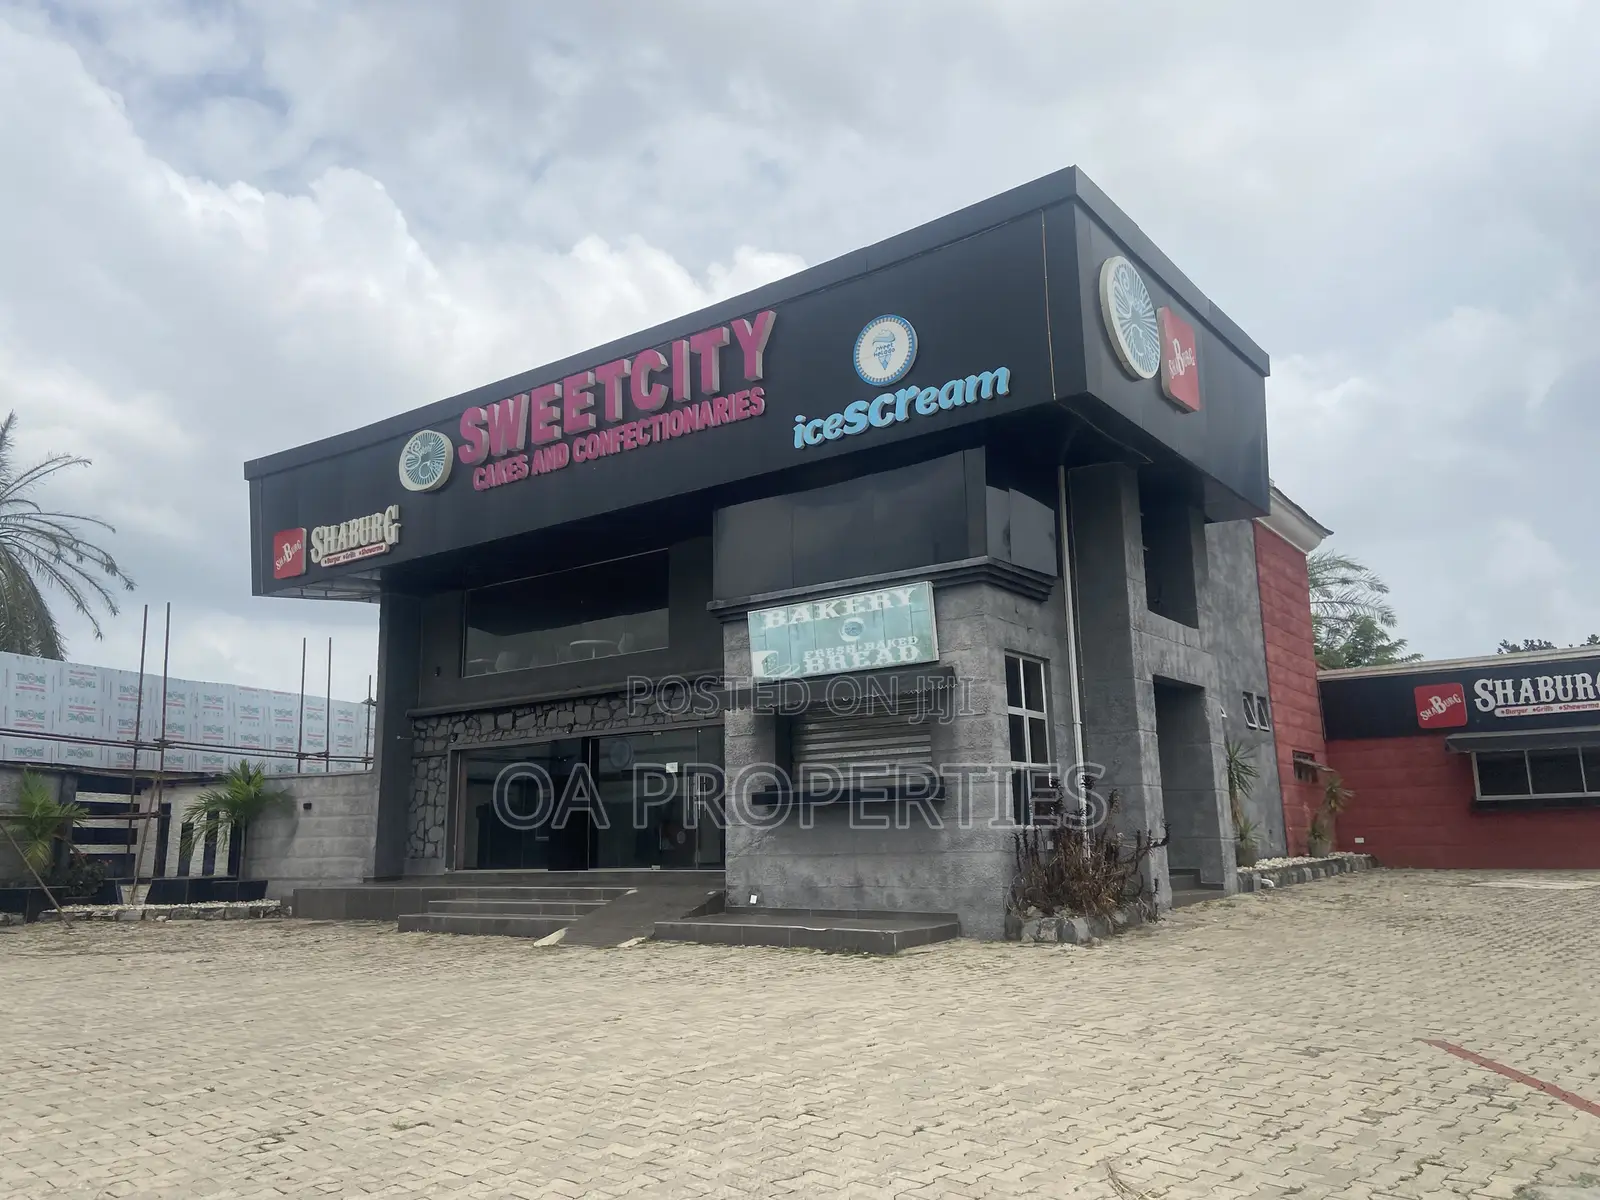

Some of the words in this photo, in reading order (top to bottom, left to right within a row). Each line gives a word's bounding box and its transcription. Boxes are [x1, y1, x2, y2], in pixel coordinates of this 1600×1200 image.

[458, 309, 777, 465] SWEETCITY
[793, 366, 1011, 449] icescream
[472, 454, 529, 491] CAKES
[531, 443, 570, 476] AND
[572, 386, 766, 463] CONFECTIONARIES
[310, 504, 402, 564] SHABURG
[762, 588, 916, 629] BAKERY
[803, 645, 922, 675] BREAD
[1474, 672, 1600, 712] SHABUR
[1505, 708, 1529, 716] Burger
